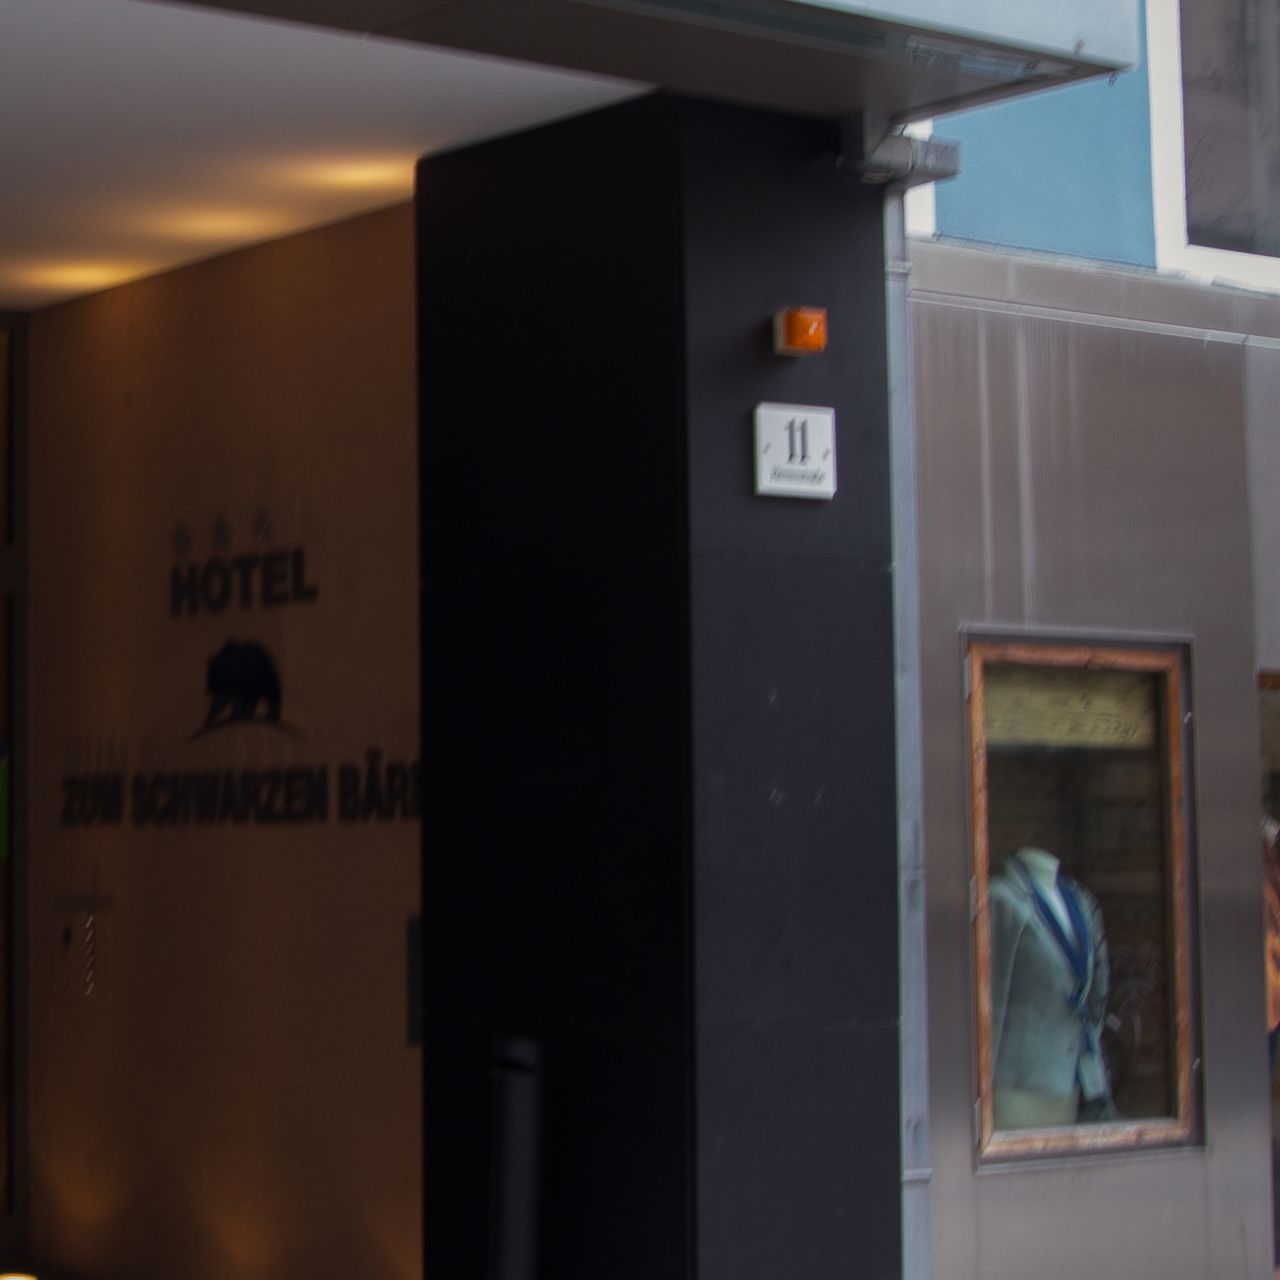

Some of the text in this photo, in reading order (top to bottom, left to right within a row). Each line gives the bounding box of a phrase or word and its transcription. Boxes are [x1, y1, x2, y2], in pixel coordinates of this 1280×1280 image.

[784, 418, 809, 465] 11
[170, 545, 319, 617] HOTEL
[60, 771, 123, 829] ZUM
[131, 763, 329, 827] SCHWARZEN
